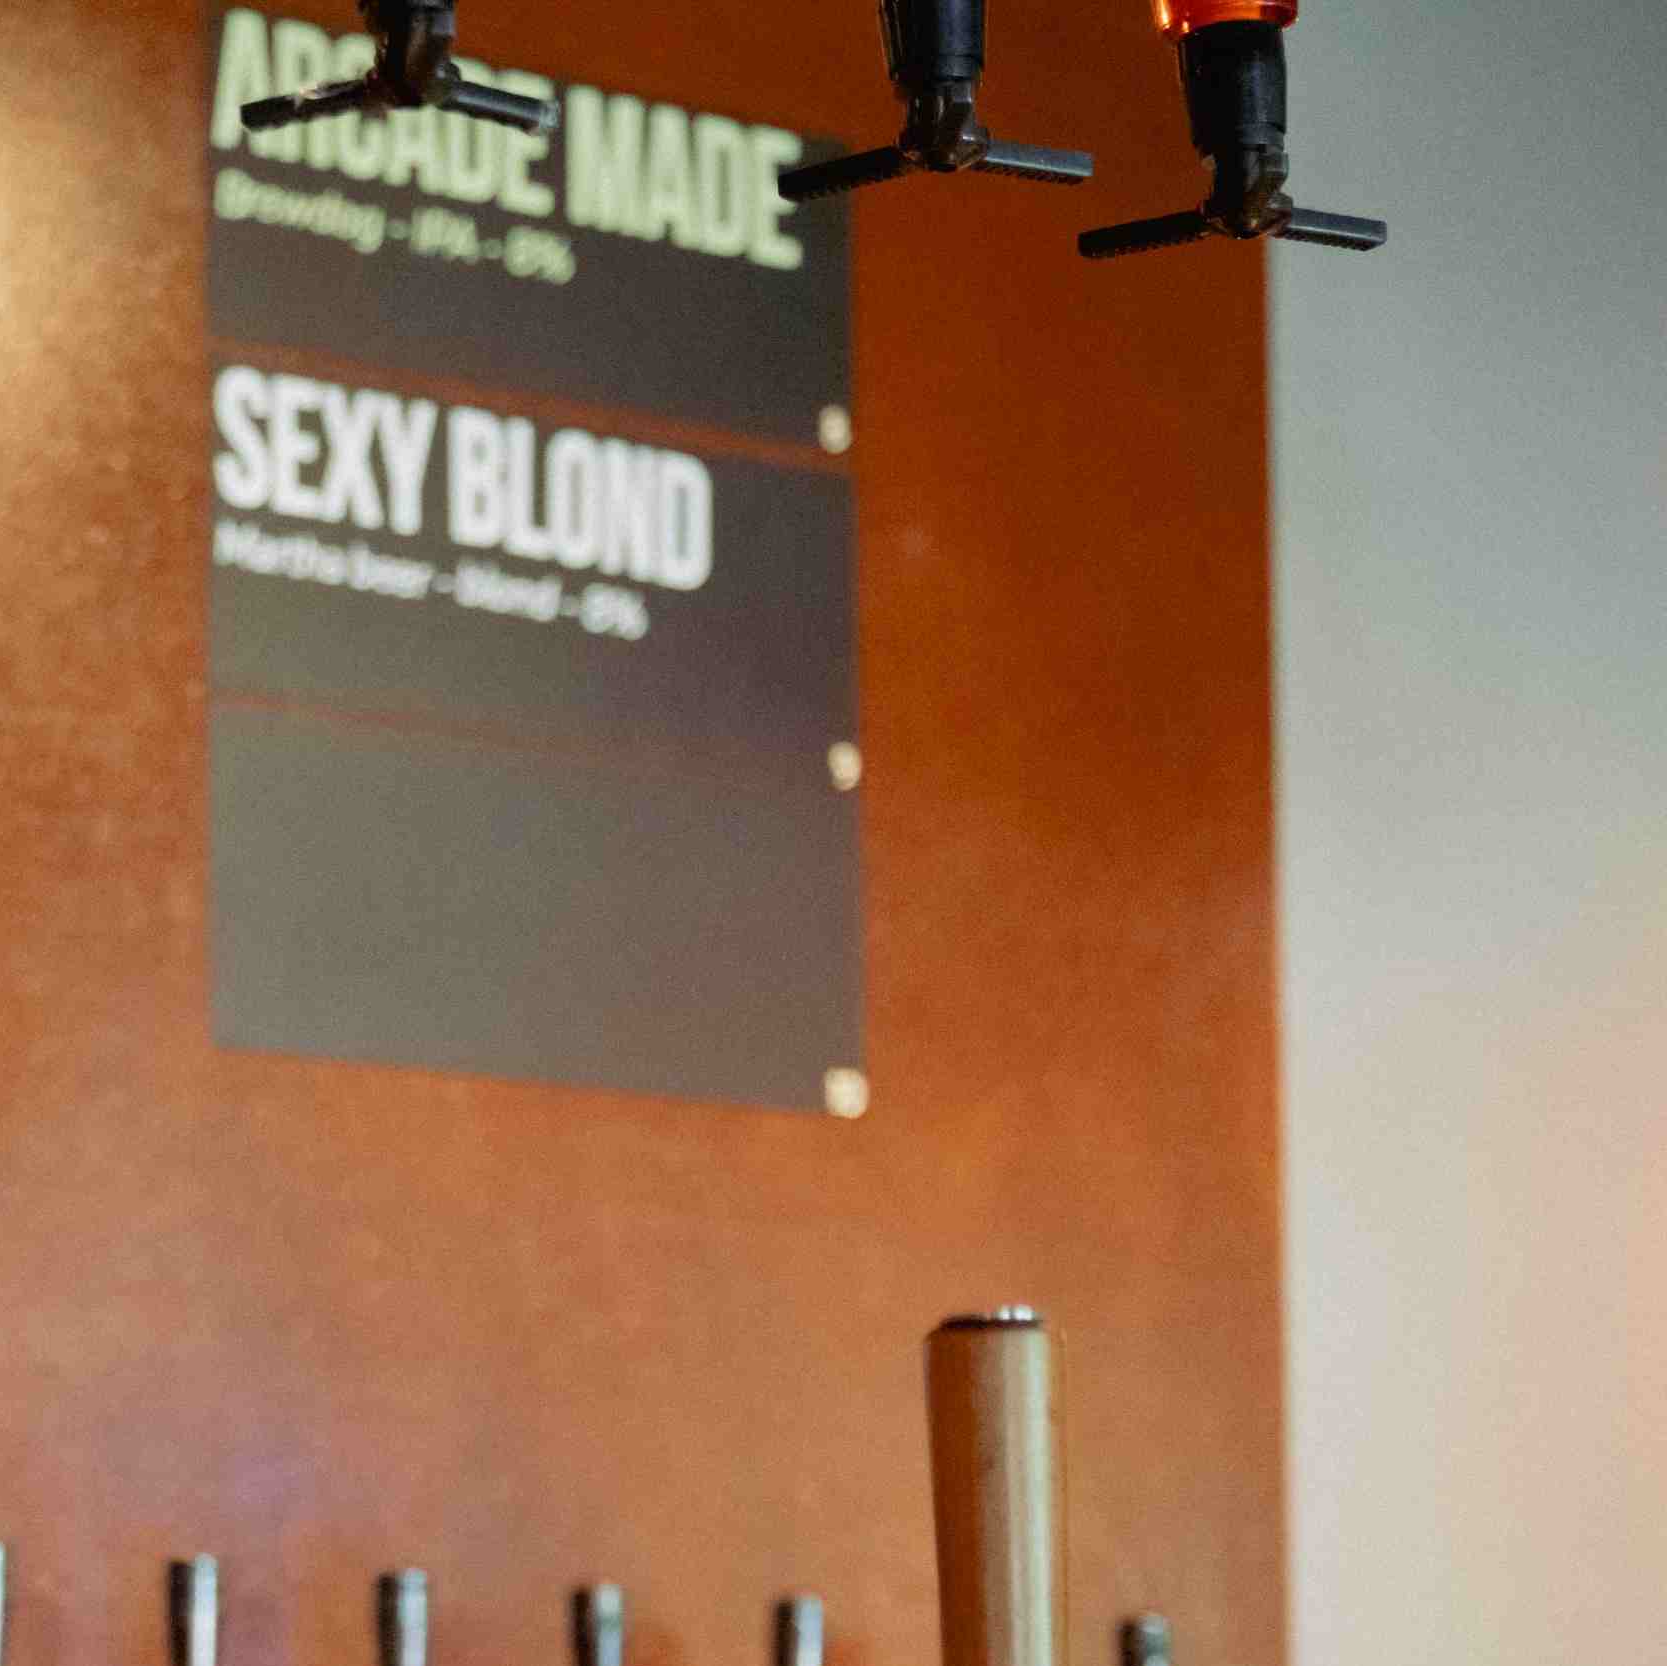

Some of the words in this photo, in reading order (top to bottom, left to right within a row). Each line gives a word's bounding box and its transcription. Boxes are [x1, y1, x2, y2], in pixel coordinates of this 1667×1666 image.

[565, 82, 803, 270] MADE
[212, 365, 438, 537] SEXY
[447, 405, 713, 591] BLOND
